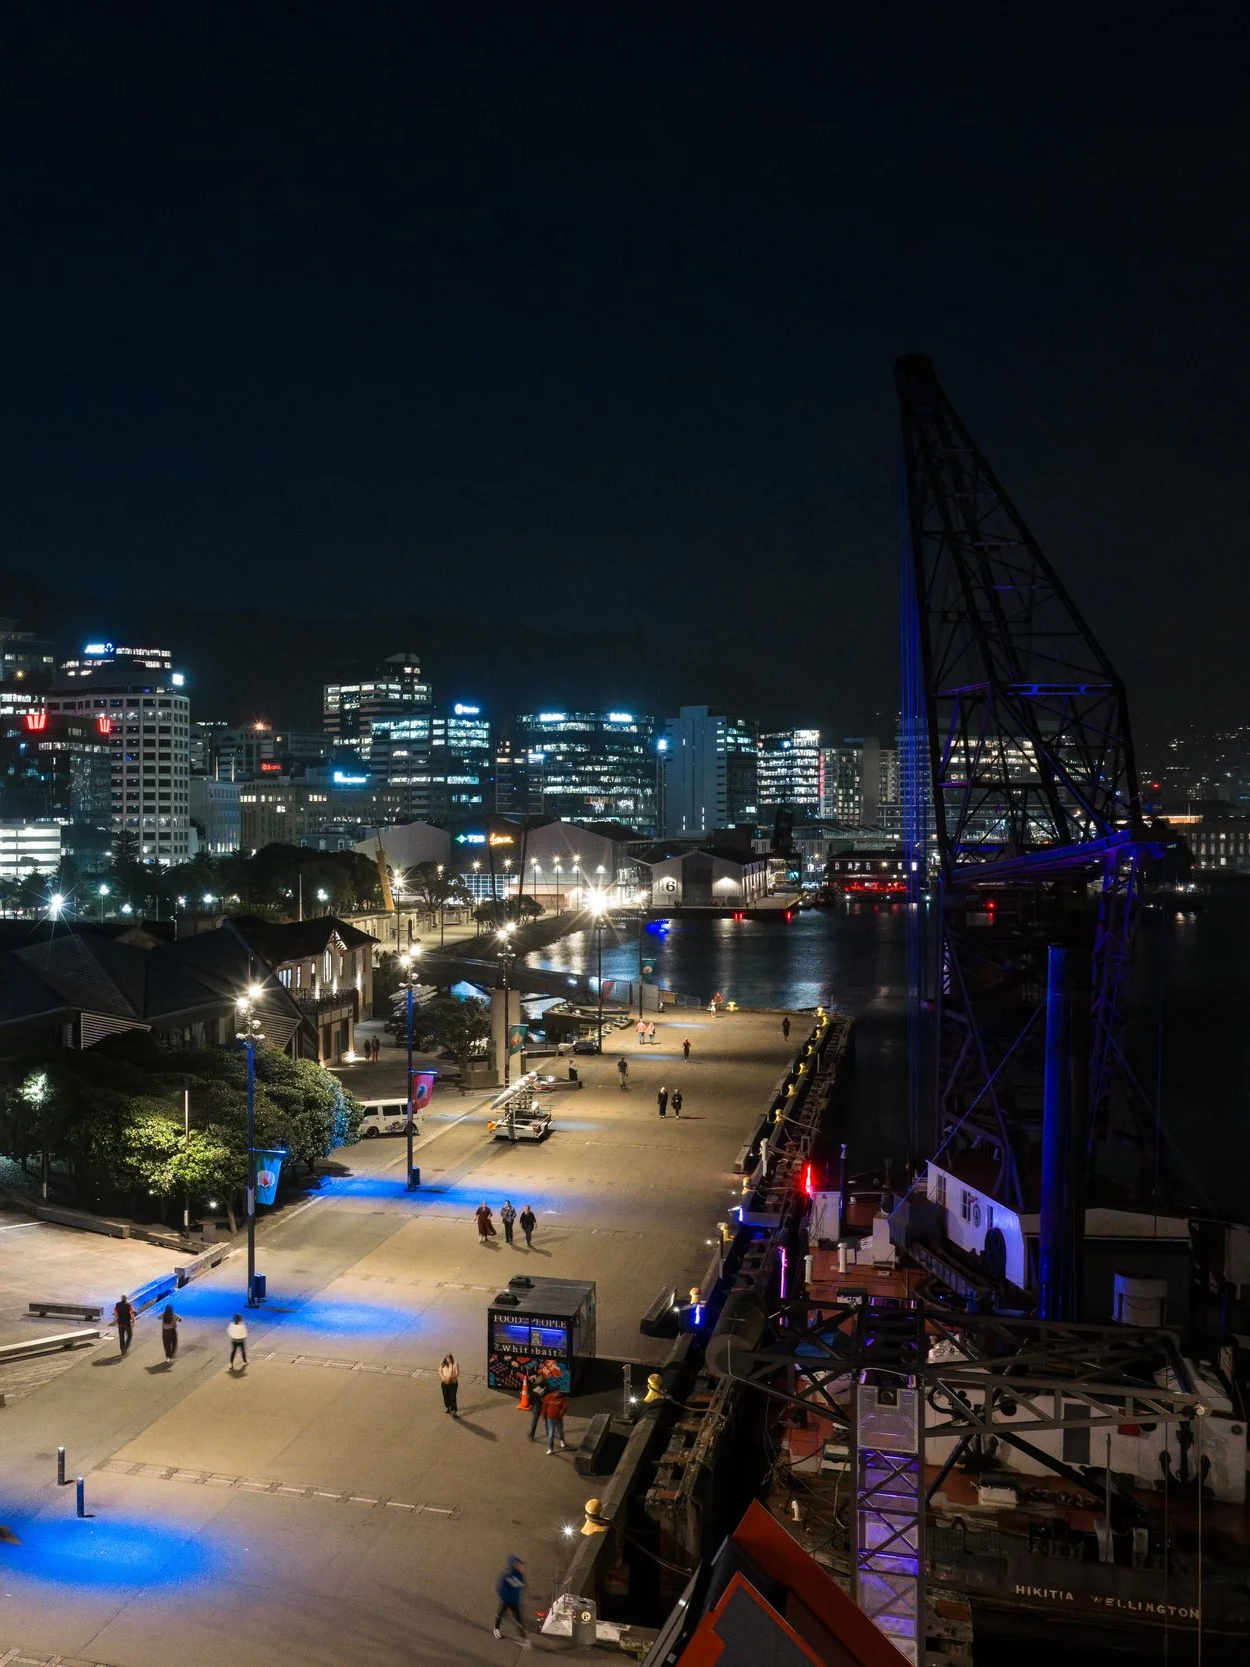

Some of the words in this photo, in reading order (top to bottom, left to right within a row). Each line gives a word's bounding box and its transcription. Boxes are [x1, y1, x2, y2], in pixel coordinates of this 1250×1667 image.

[467, 834, 485, 843] TSB
[666, 881, 676, 892] 6
[494, 1314, 522, 1325] FOOD
[531, 1318, 567, 1329] PEOPLE
[1015, 1584, 1074, 1601] HIKITIA
